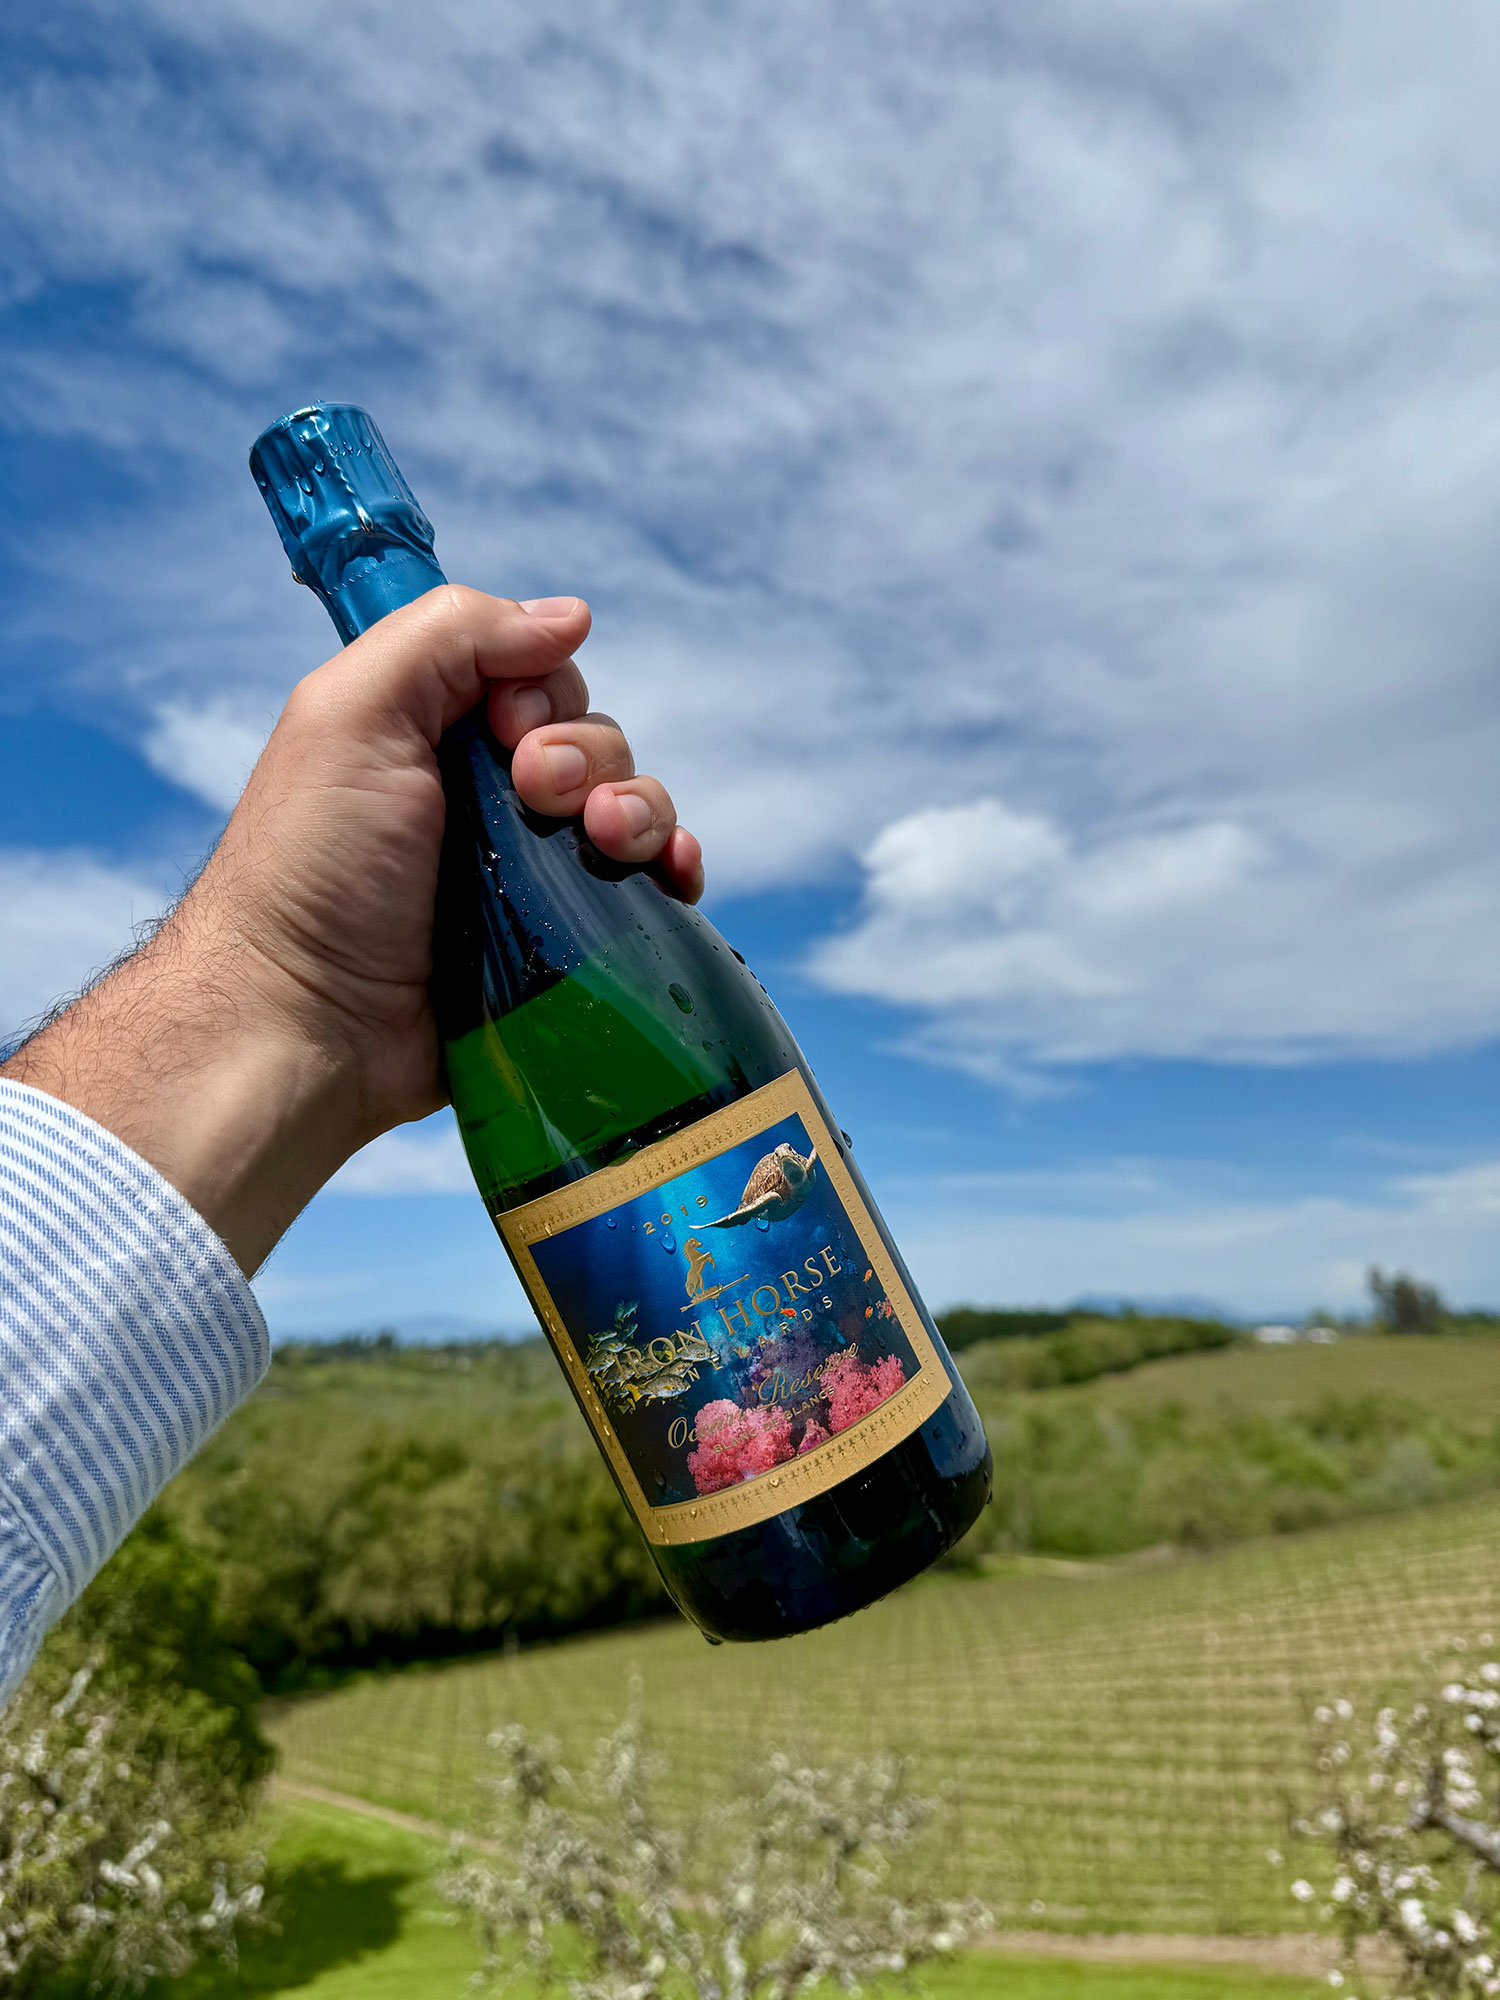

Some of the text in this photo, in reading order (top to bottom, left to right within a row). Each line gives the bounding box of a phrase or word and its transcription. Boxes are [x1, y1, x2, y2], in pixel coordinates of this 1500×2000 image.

[642, 1195, 708, 1235] 2019
[612, 1245, 842, 1381] IRON HORSE
[662, 1296, 832, 1392] NEYARDS
[754, 1342, 859, 1411] Reserve
[713, 1385, 836, 1454] BLANC DE BLANCS
